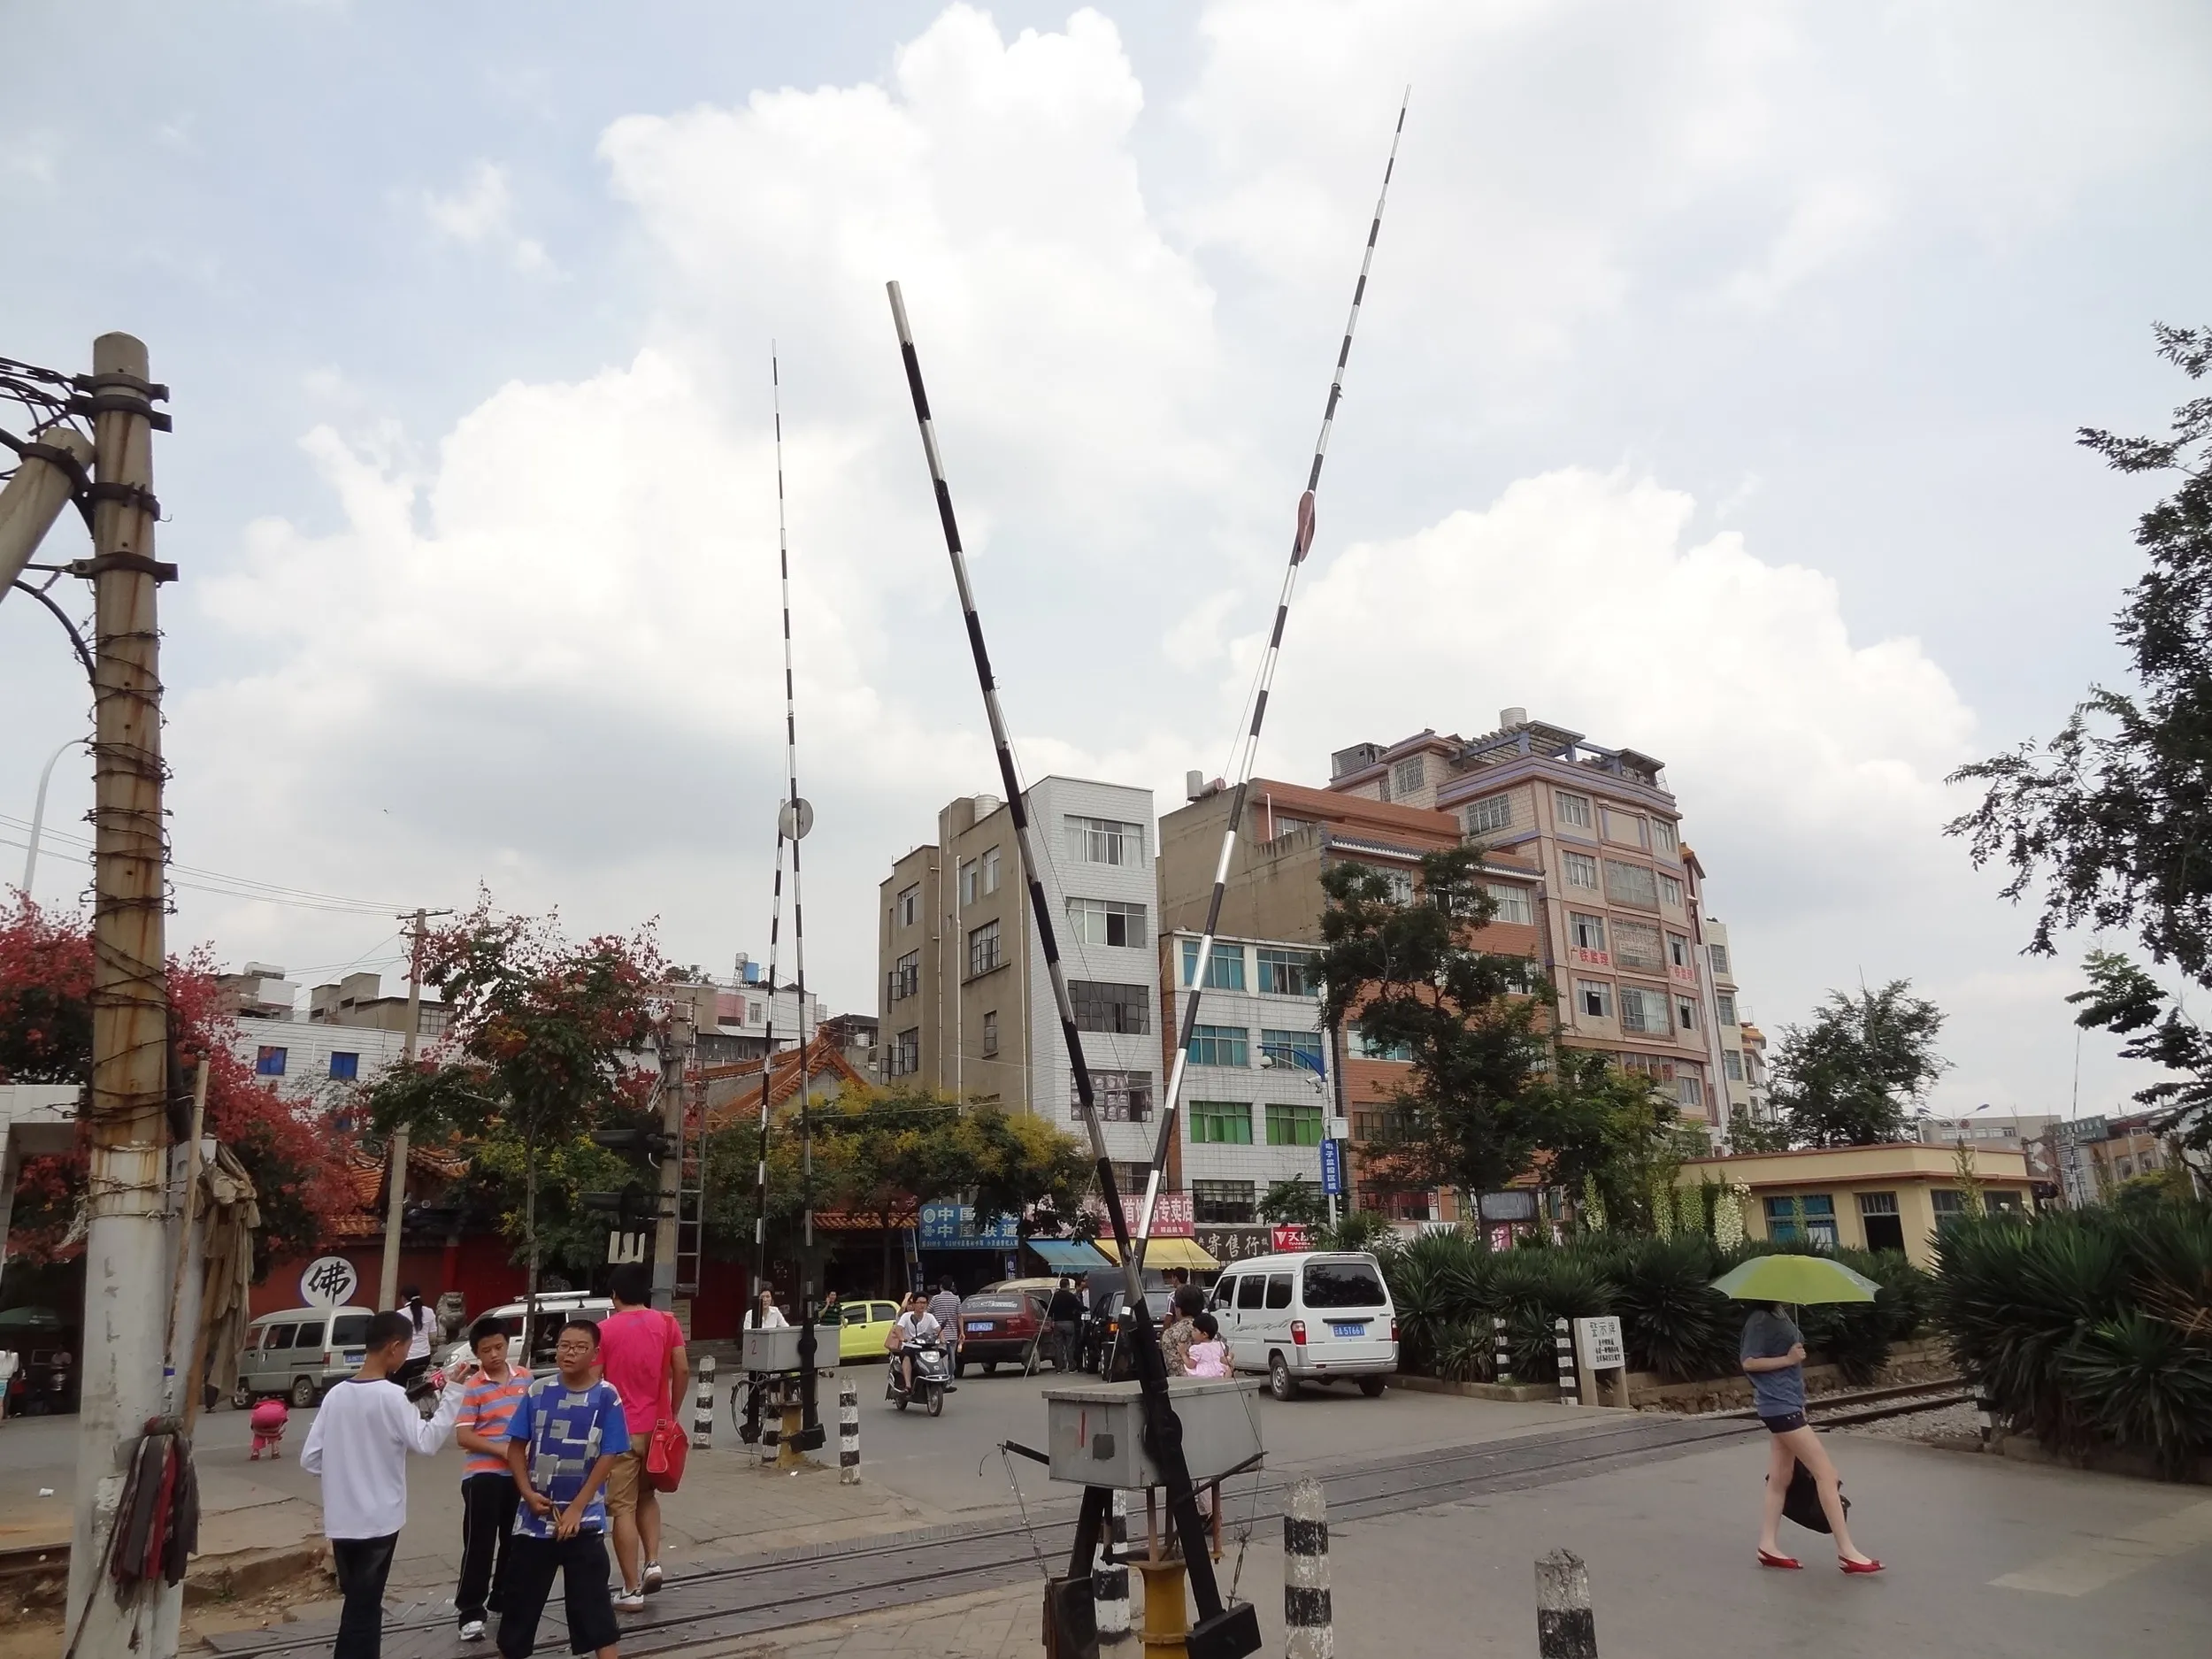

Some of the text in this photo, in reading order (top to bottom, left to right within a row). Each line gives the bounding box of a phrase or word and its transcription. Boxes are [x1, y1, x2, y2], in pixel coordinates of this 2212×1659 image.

[1571, 947, 1609, 965] 广铁监理
[1325, 1142, 1337, 1190] 电子监控区域
[1207, 1233, 1259, 1258] 寄售行
[307, 1261, 350, 1305] 佛
[1589, 1321, 1617, 1338] 警示牌
[751, 1340, 757, 1355] 2
